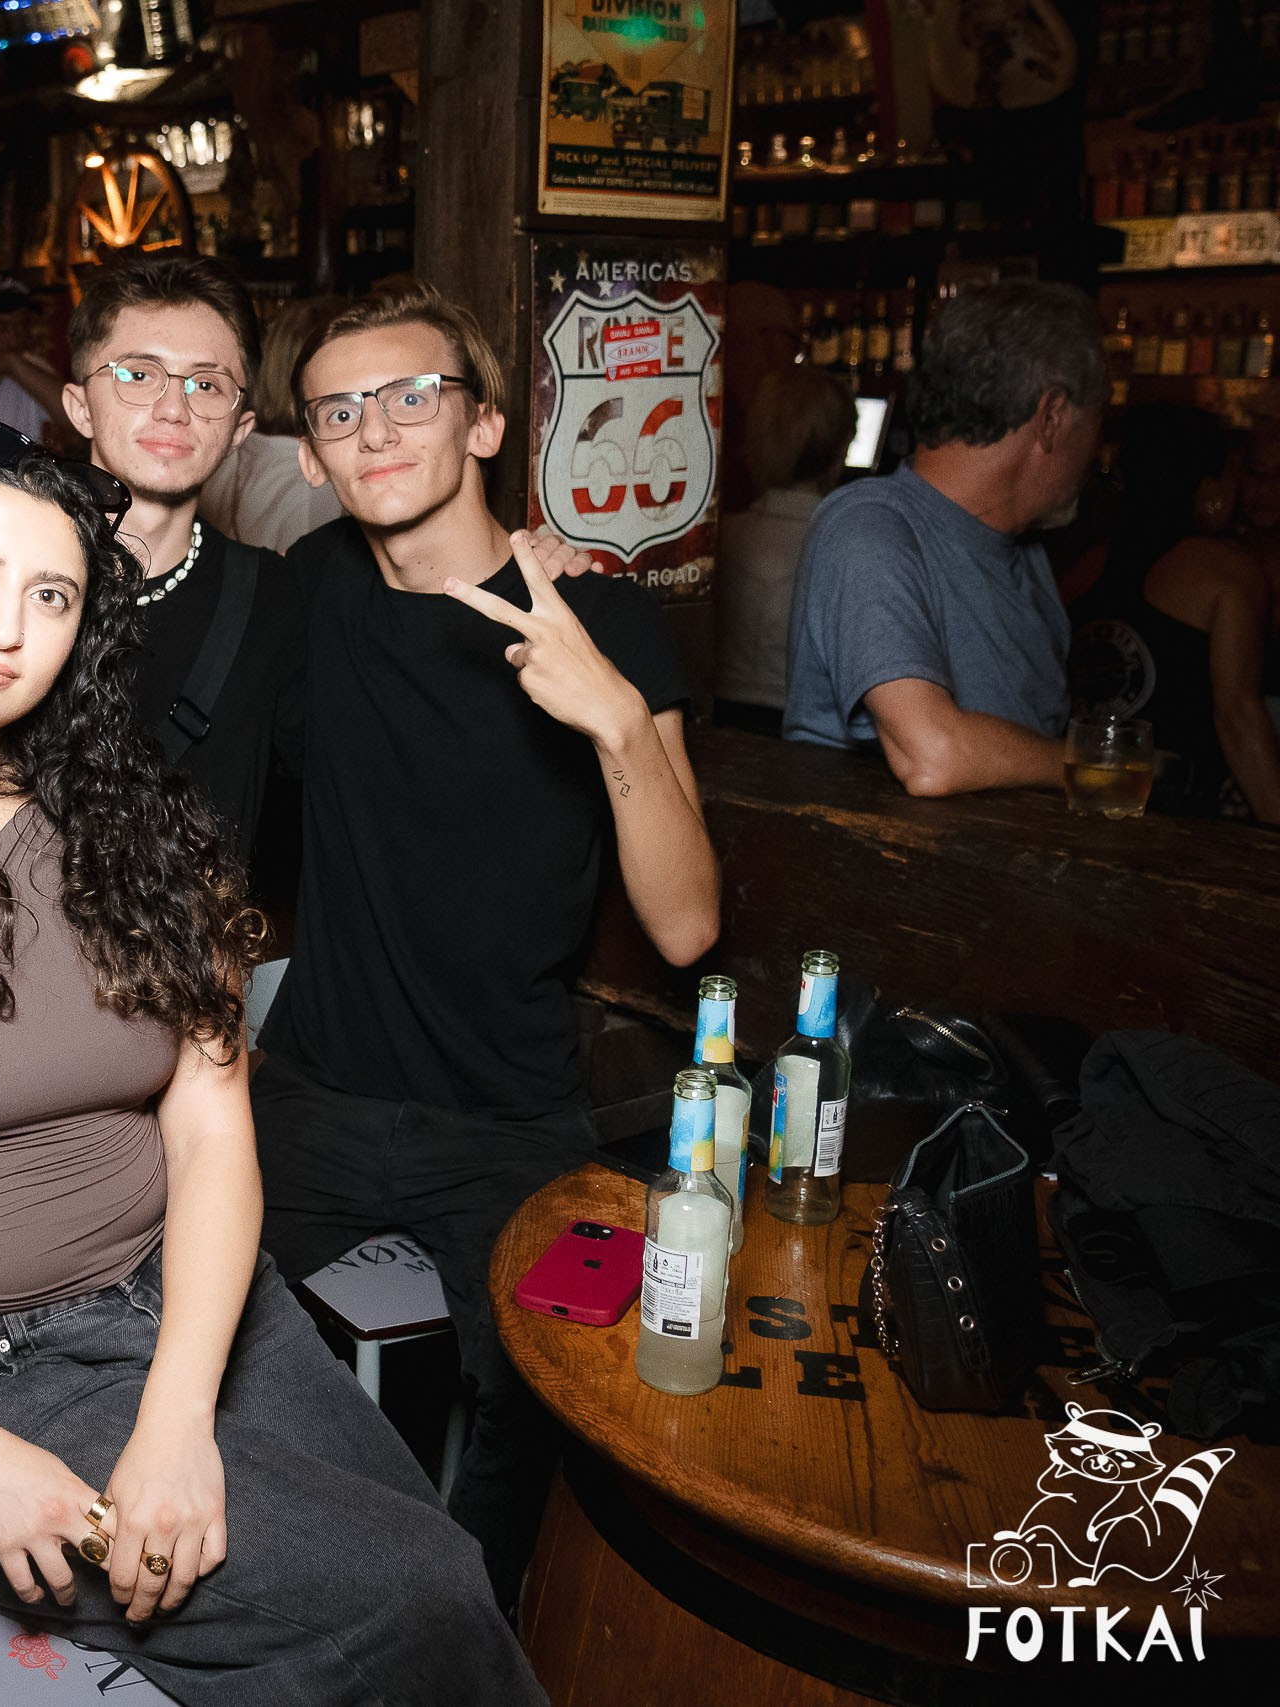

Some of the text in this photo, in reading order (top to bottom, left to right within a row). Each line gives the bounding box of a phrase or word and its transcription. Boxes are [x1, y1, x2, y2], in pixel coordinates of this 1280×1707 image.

[575, 261, 693, 283] AMERICA'S
[570, 396, 690, 527] 66
[646, 565, 701, 588] ROAD
